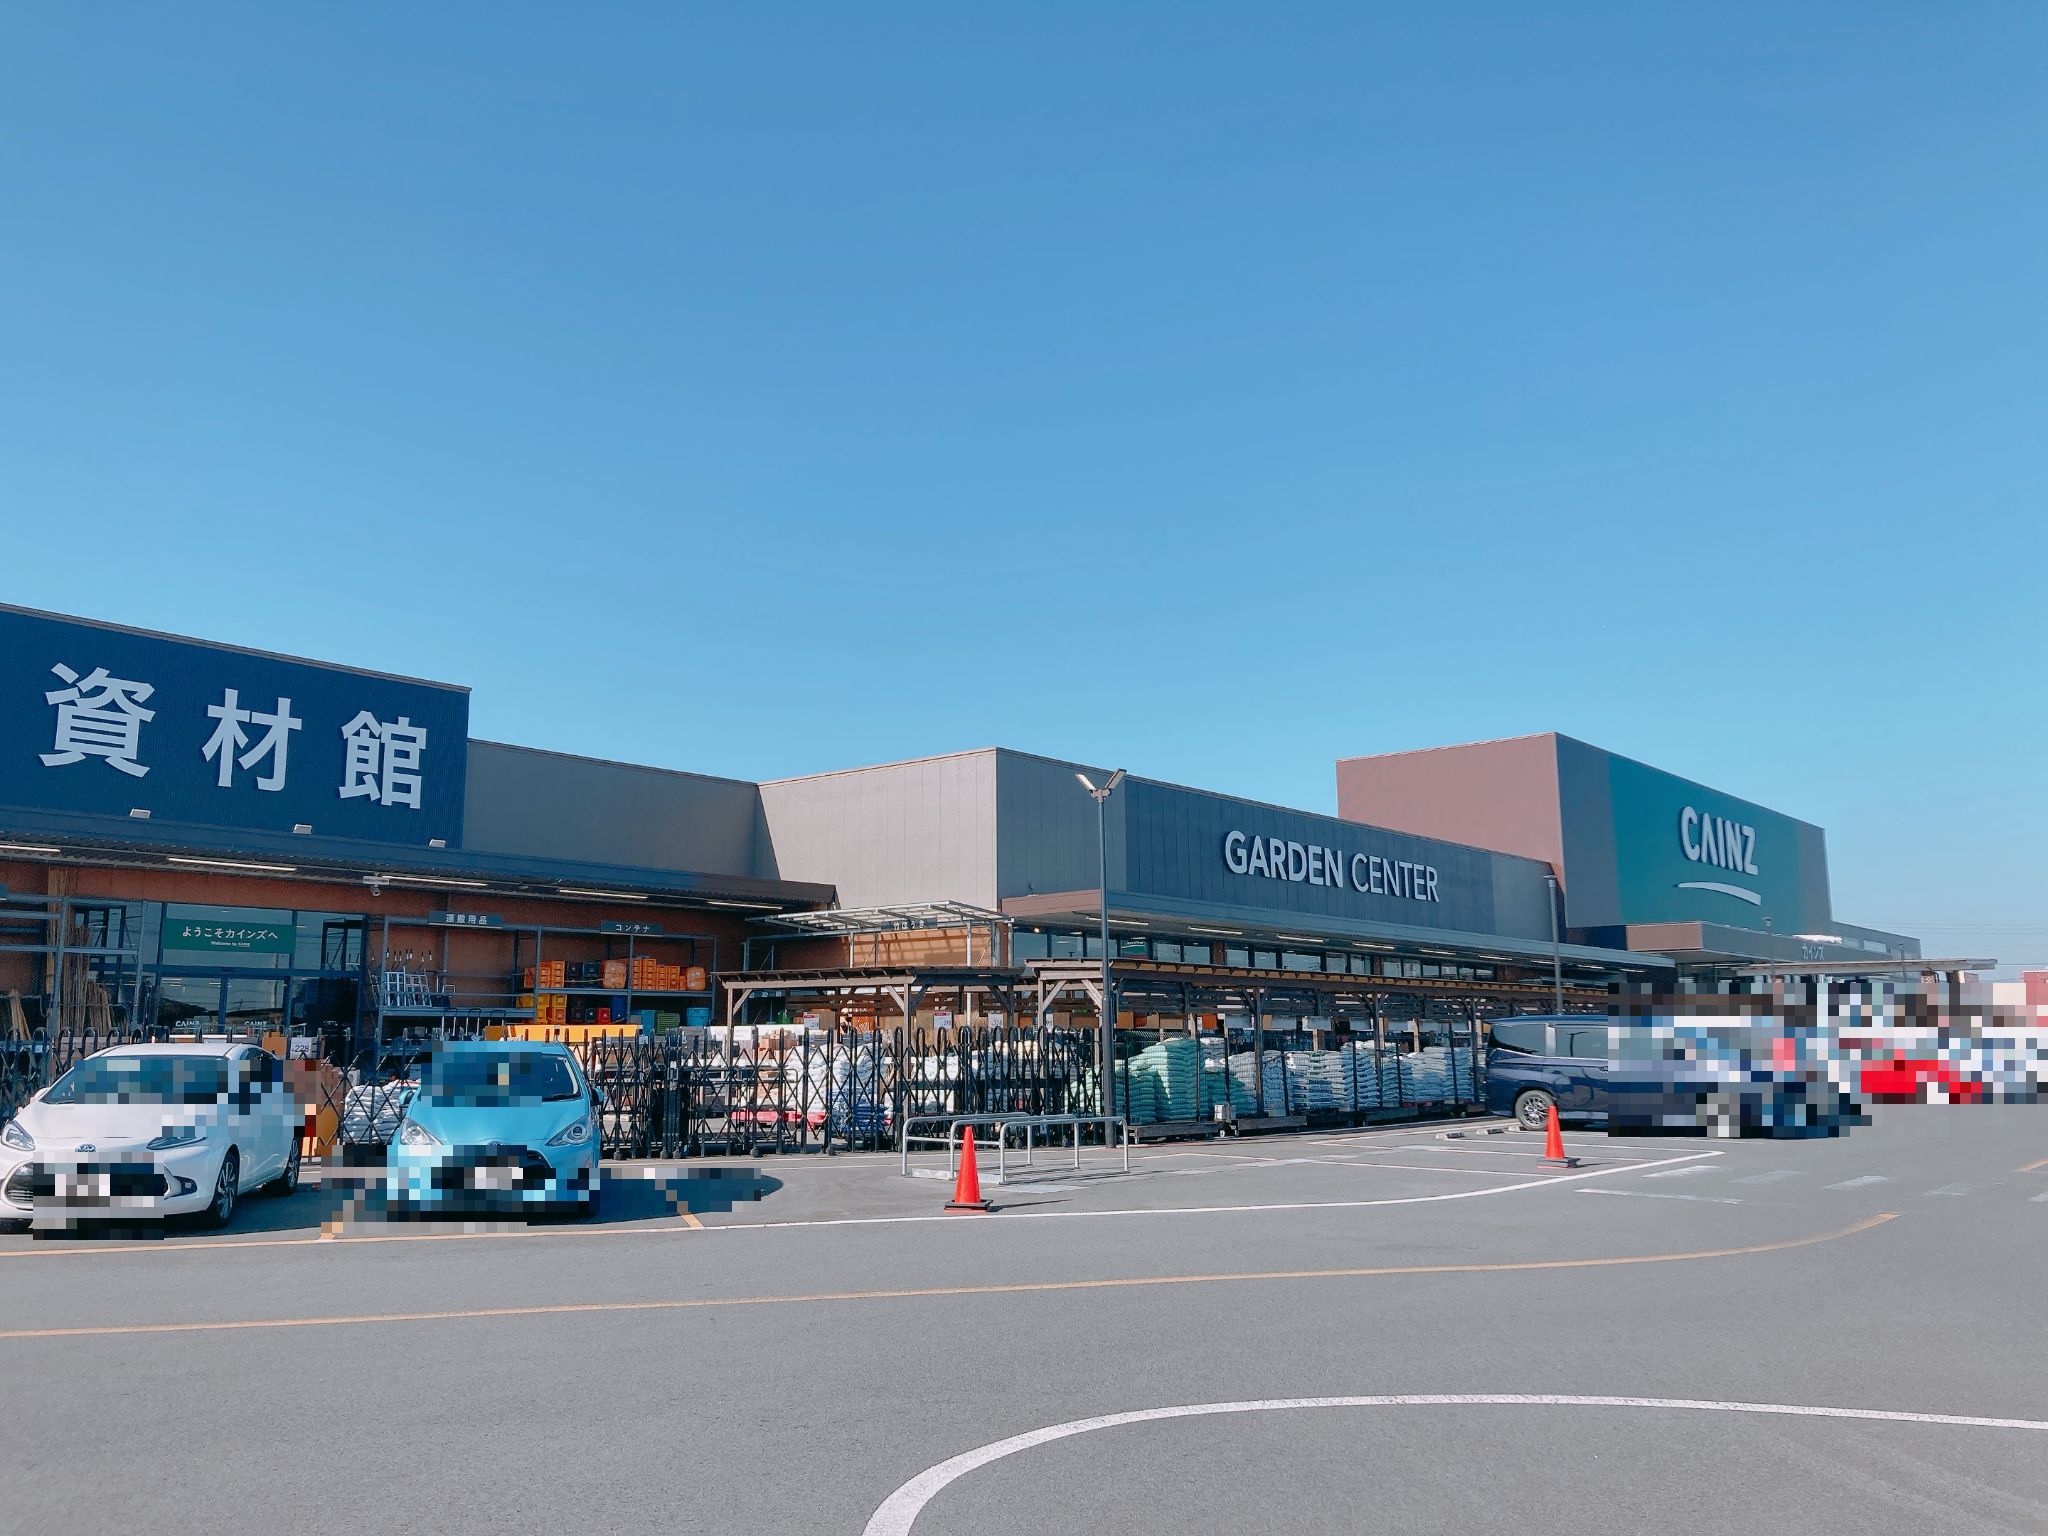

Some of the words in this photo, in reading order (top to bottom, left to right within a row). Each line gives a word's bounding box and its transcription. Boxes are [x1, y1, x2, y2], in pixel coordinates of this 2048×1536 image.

[39, 663, 427, 809] 資材館
[1681, 806, 1759, 875] CAINZ
[1225, 830, 1344, 888] GARDEN
[1351, 853, 1440, 902] CENTER
[182, 926, 279, 940] ようこそカインズへ
[615, 924, 650, 933] コンテナ
[1801, 943, 1825, 962] カインズ
